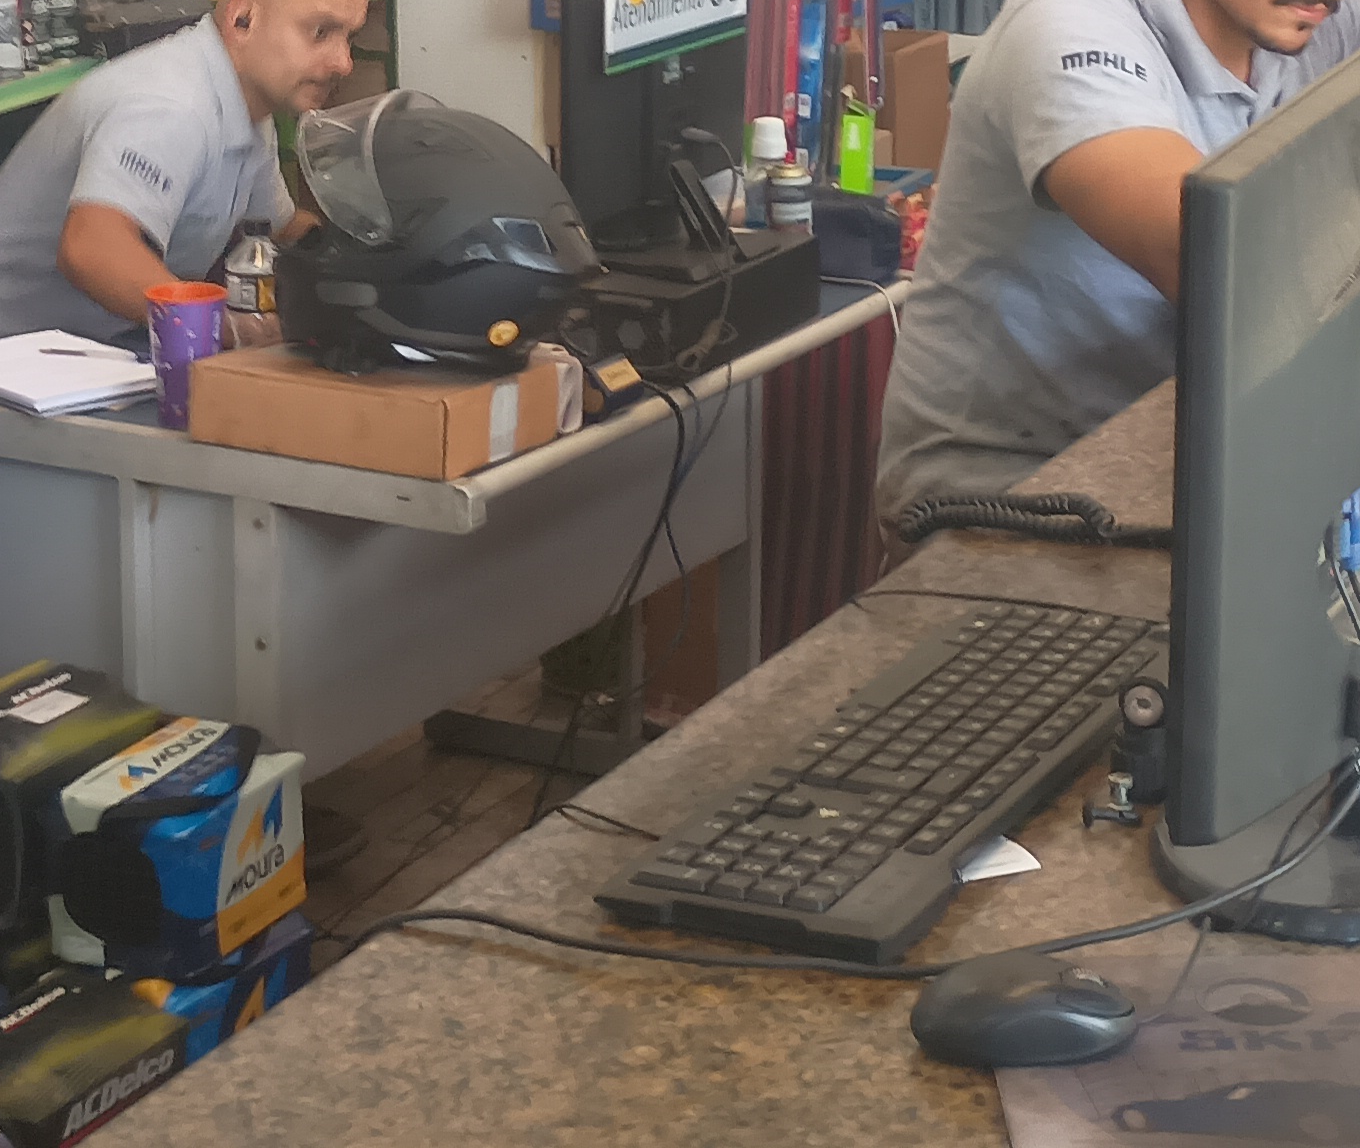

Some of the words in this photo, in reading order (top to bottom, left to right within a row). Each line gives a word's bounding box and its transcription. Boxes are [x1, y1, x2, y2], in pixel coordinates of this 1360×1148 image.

[1061, 50, 1148, 83] MAHLE
[225, 843, 285, 905] Moura
[63, 1048, 175, 1139] ACDelco
